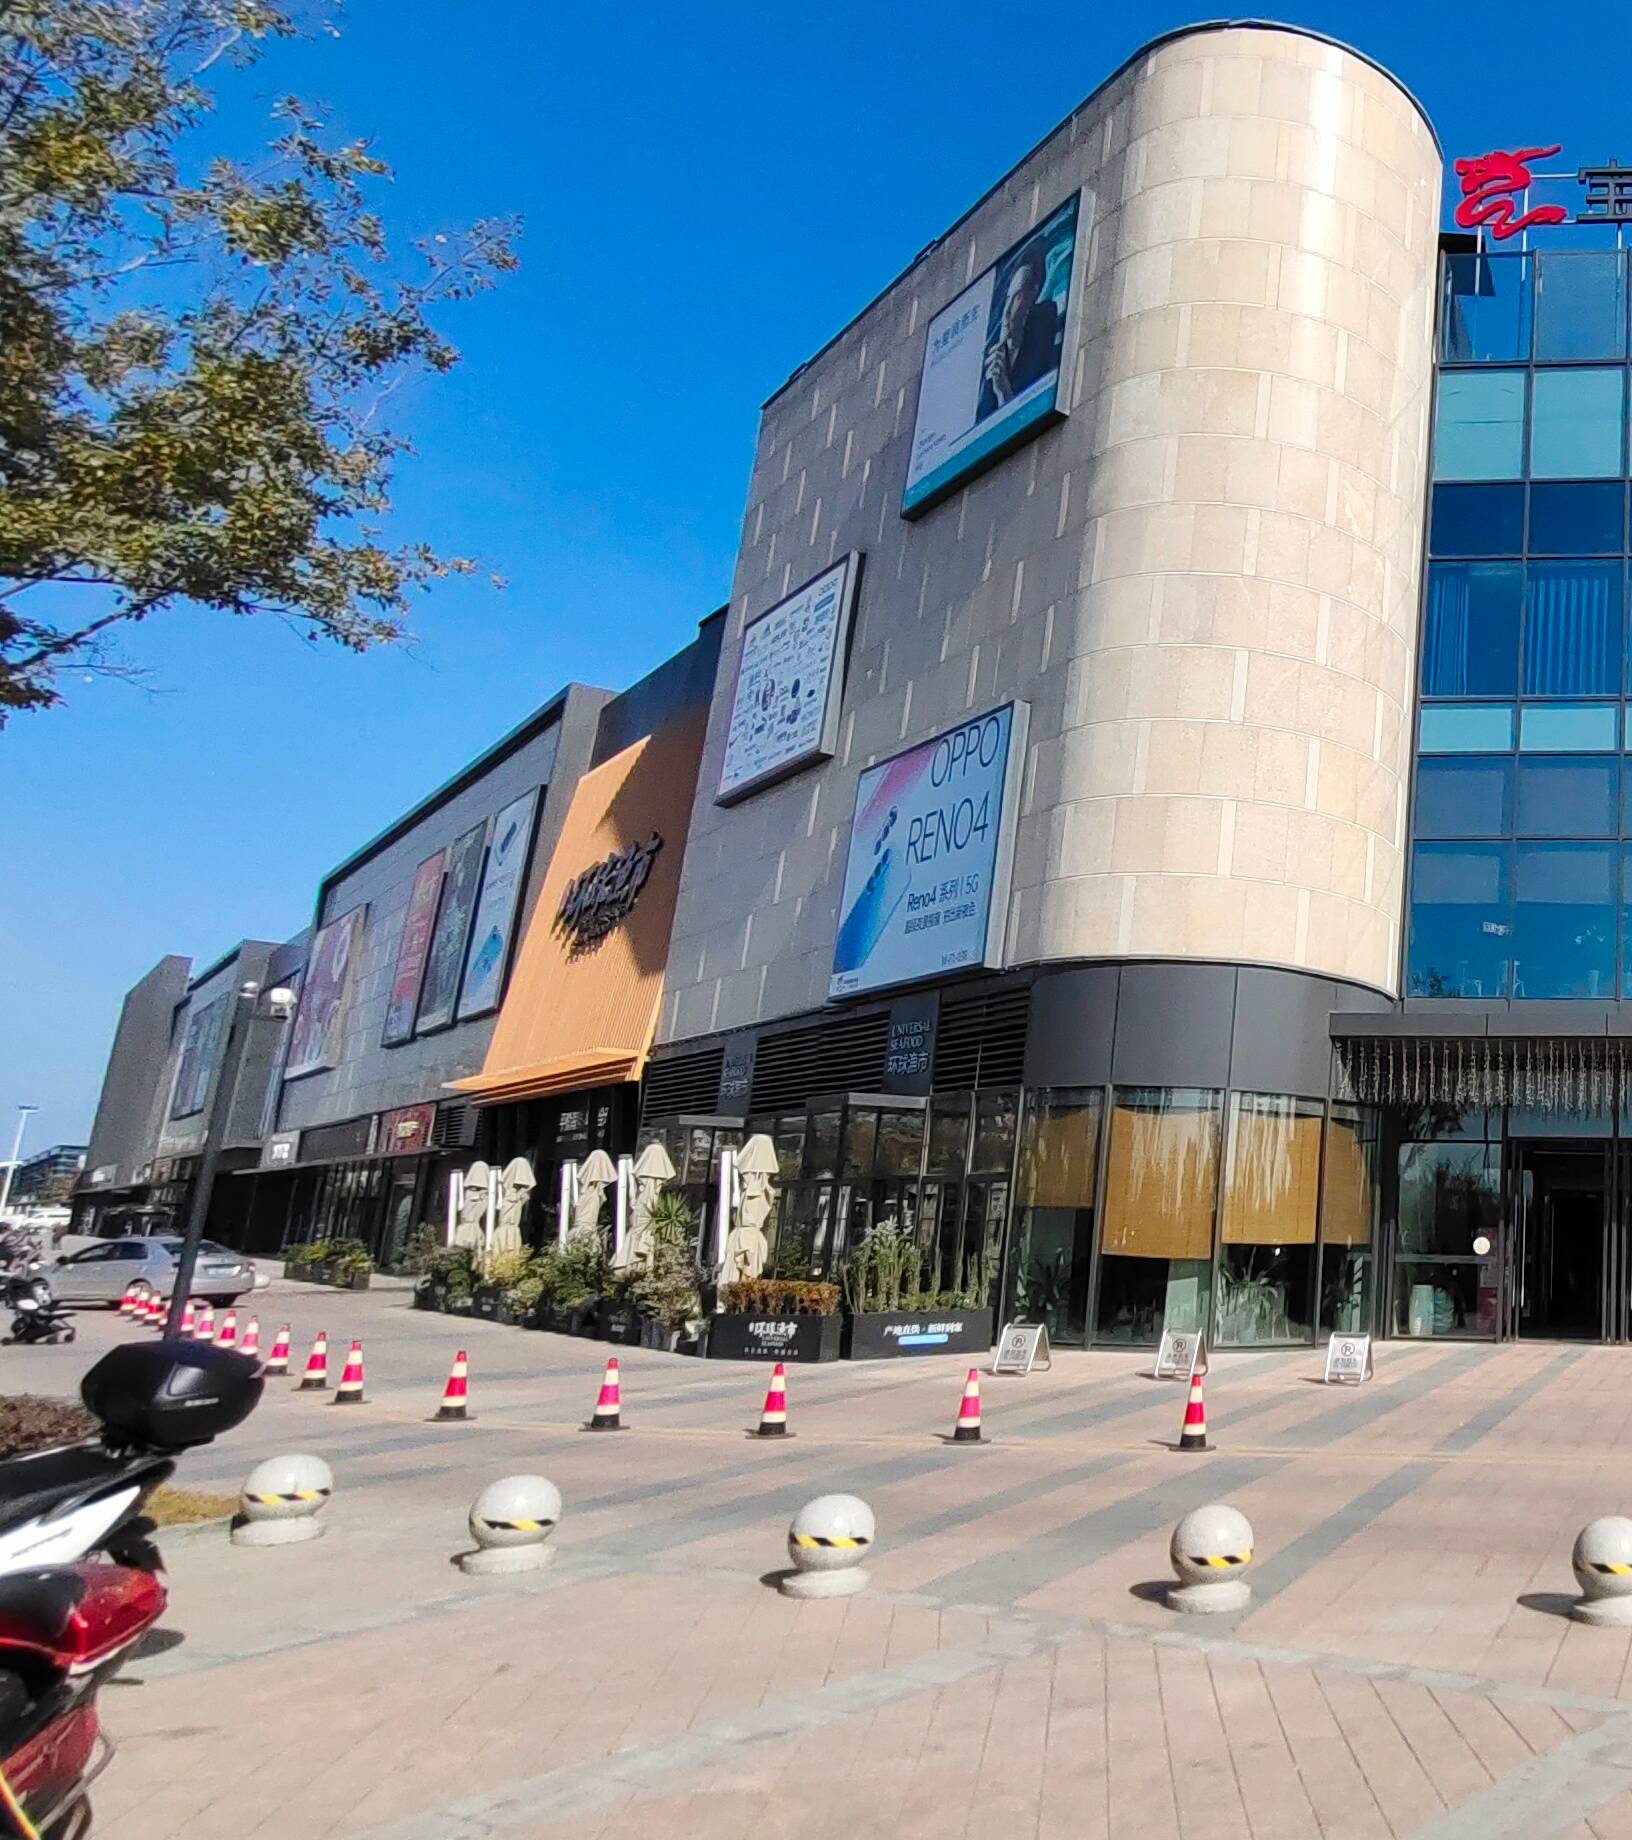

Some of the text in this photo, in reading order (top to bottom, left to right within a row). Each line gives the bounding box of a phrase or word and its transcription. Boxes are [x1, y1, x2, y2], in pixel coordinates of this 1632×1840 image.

[930, 715, 1001, 789] OPPO
[906, 790, 990, 866] RENO4
[907, 885, 937, 912] Reno4
[965, 873, 980, 895] 5G
